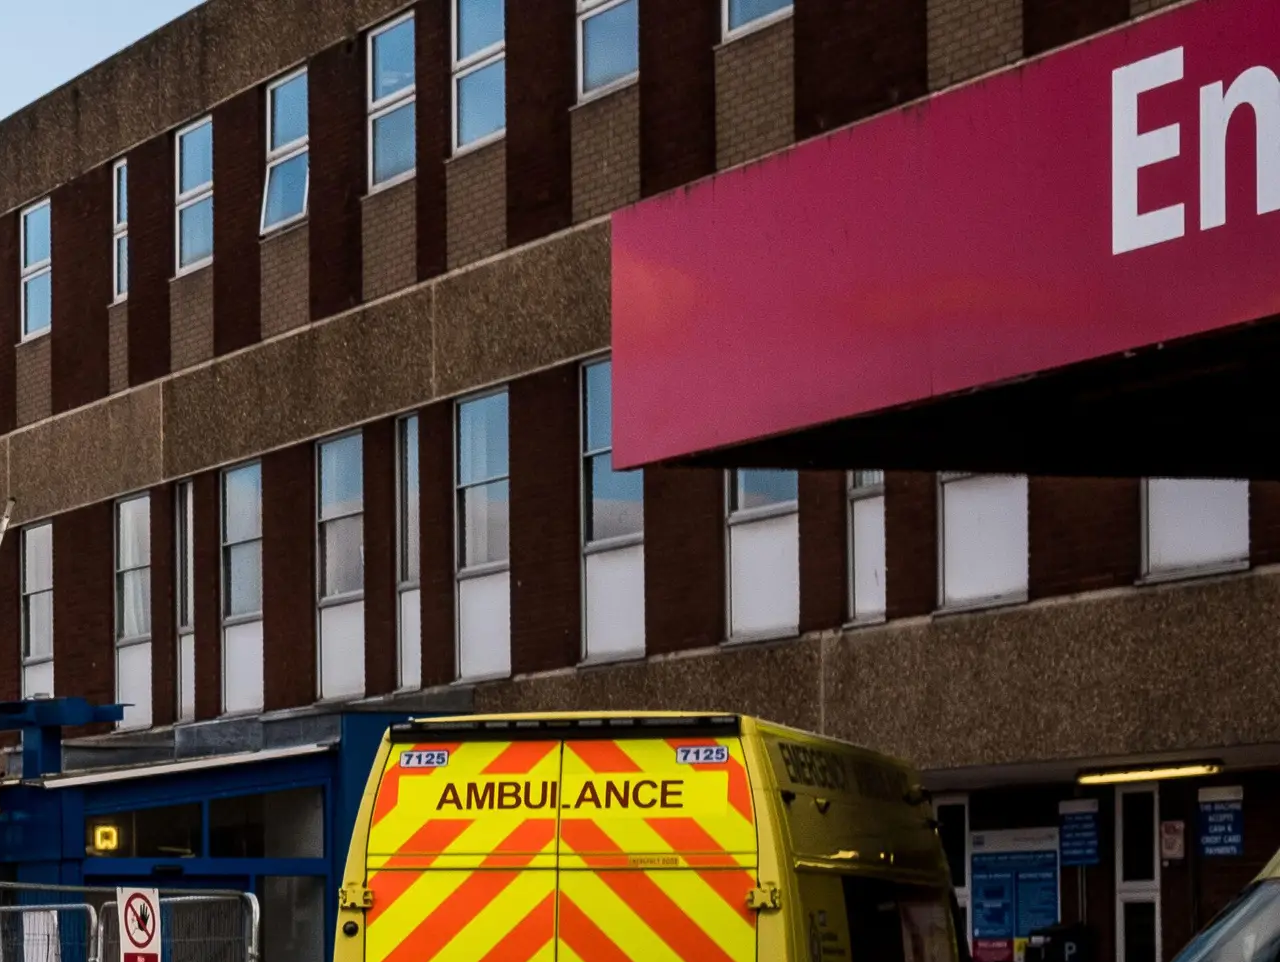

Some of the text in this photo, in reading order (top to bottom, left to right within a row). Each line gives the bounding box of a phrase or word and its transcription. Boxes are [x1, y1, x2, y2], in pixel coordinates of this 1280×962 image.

[1112, 45, 1280, 256] En
[403, 752, 446, 767] 7125
[680, 747, 727, 763] 7125
[435, 779, 684, 811] AMBULANCE
